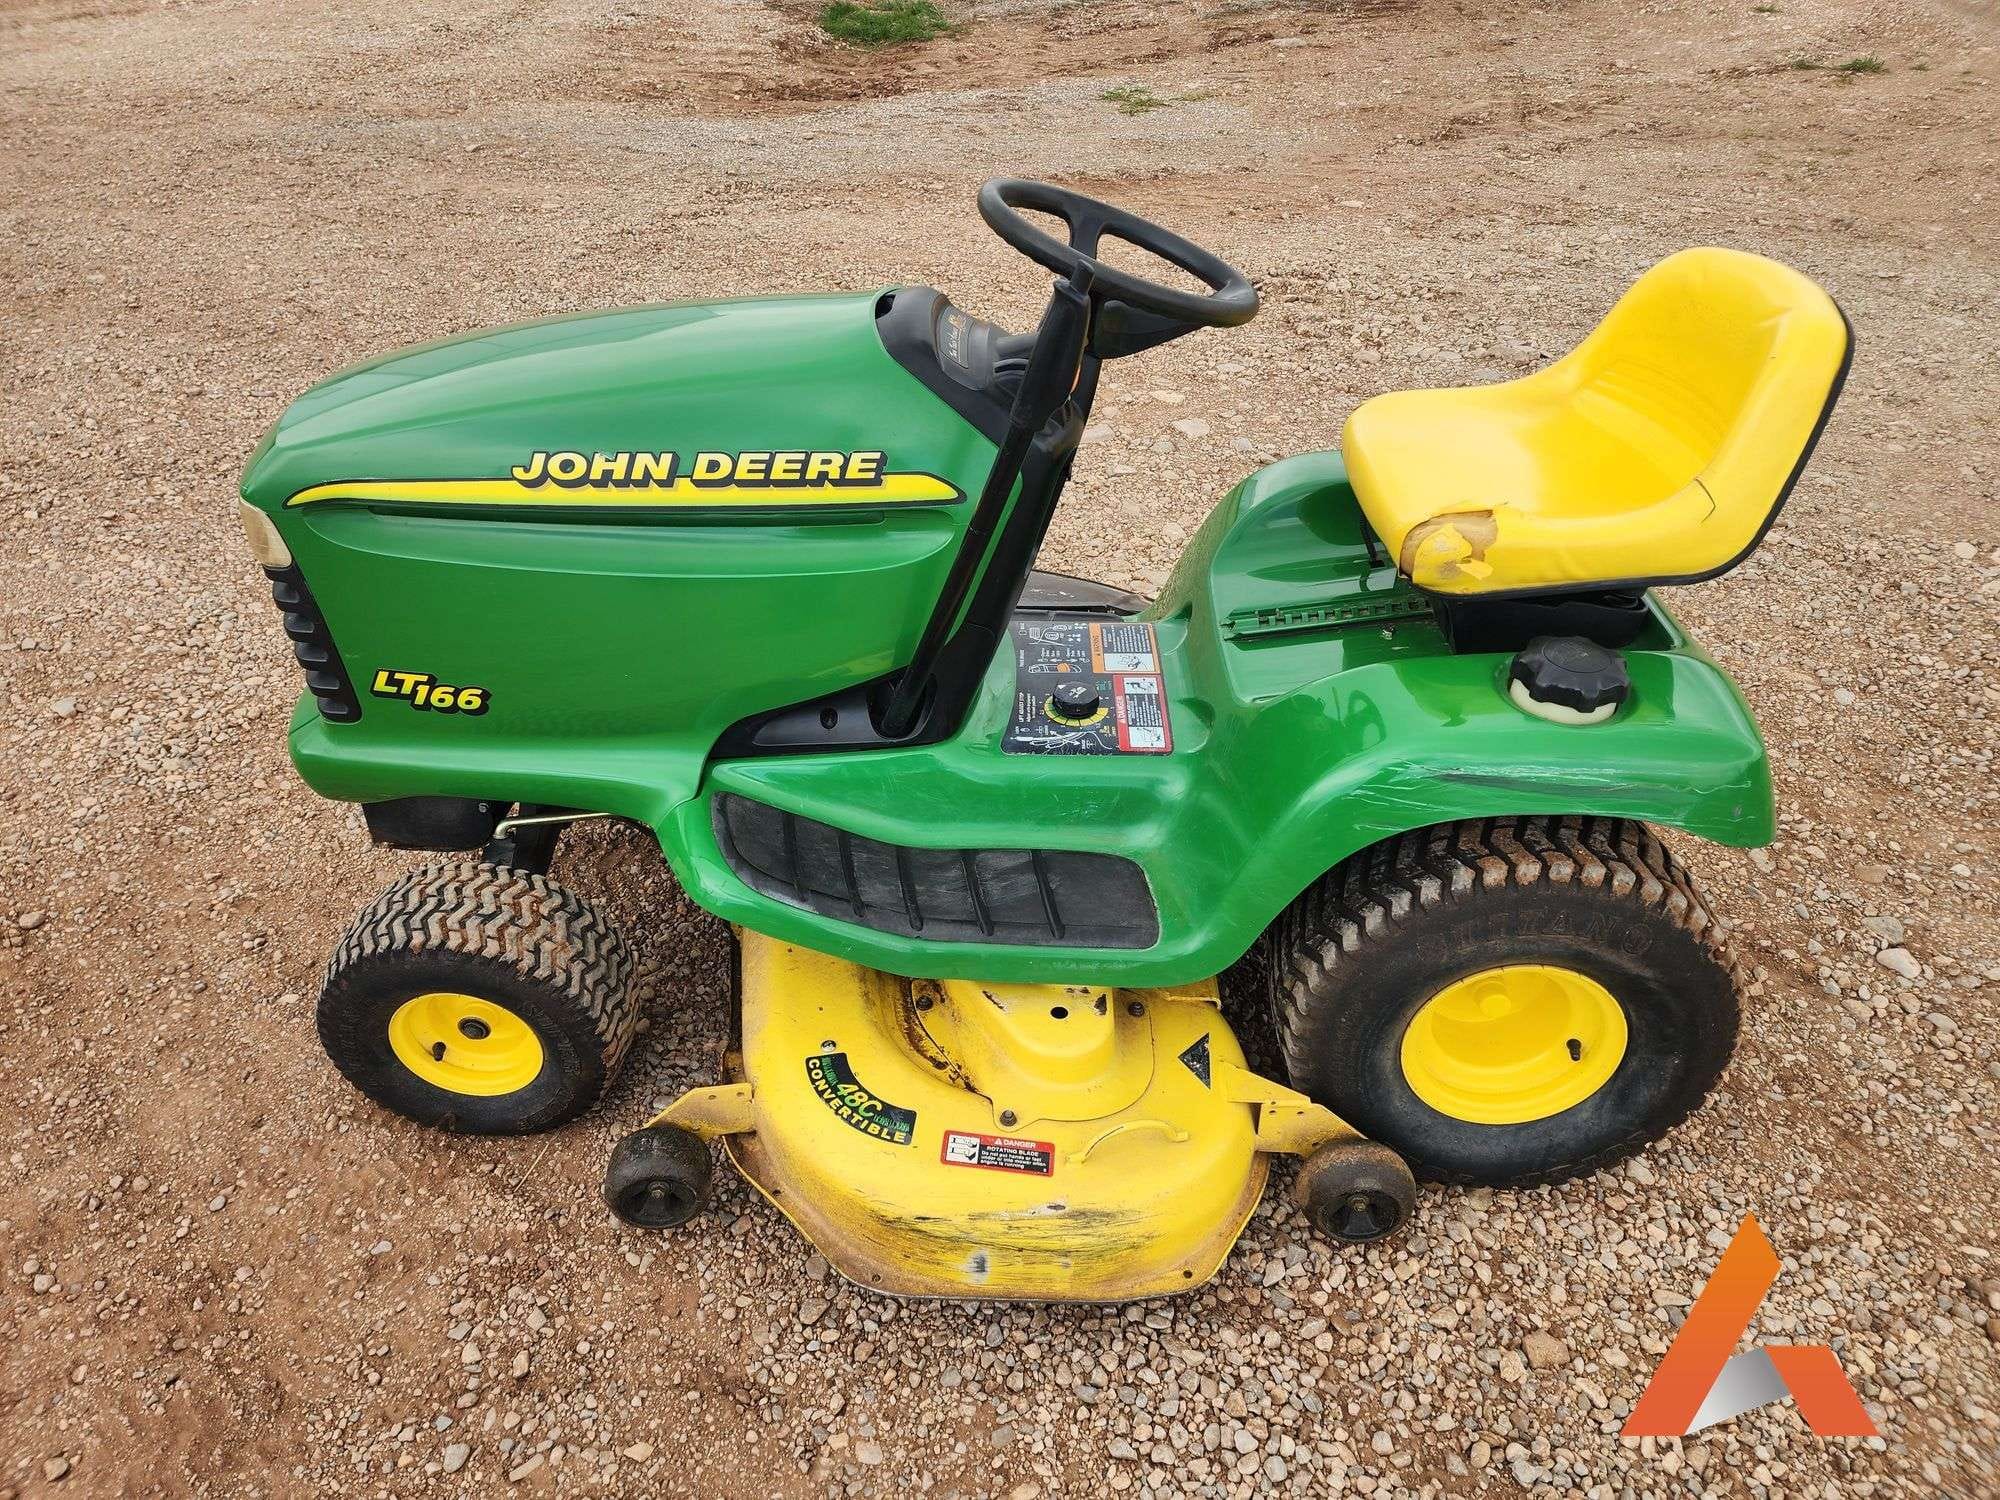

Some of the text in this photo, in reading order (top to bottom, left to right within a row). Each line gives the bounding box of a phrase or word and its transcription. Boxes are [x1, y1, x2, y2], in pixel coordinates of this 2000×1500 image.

[511, 451, 887, 488] JOHN DEERE
[808, 1059, 907, 1143] CONVERTIBLE
[837, 1084, 882, 1117] 48C
[987, 1146, 1018, 1155] ROTATING
[1003, 1140, 1036, 1149] DANGER
